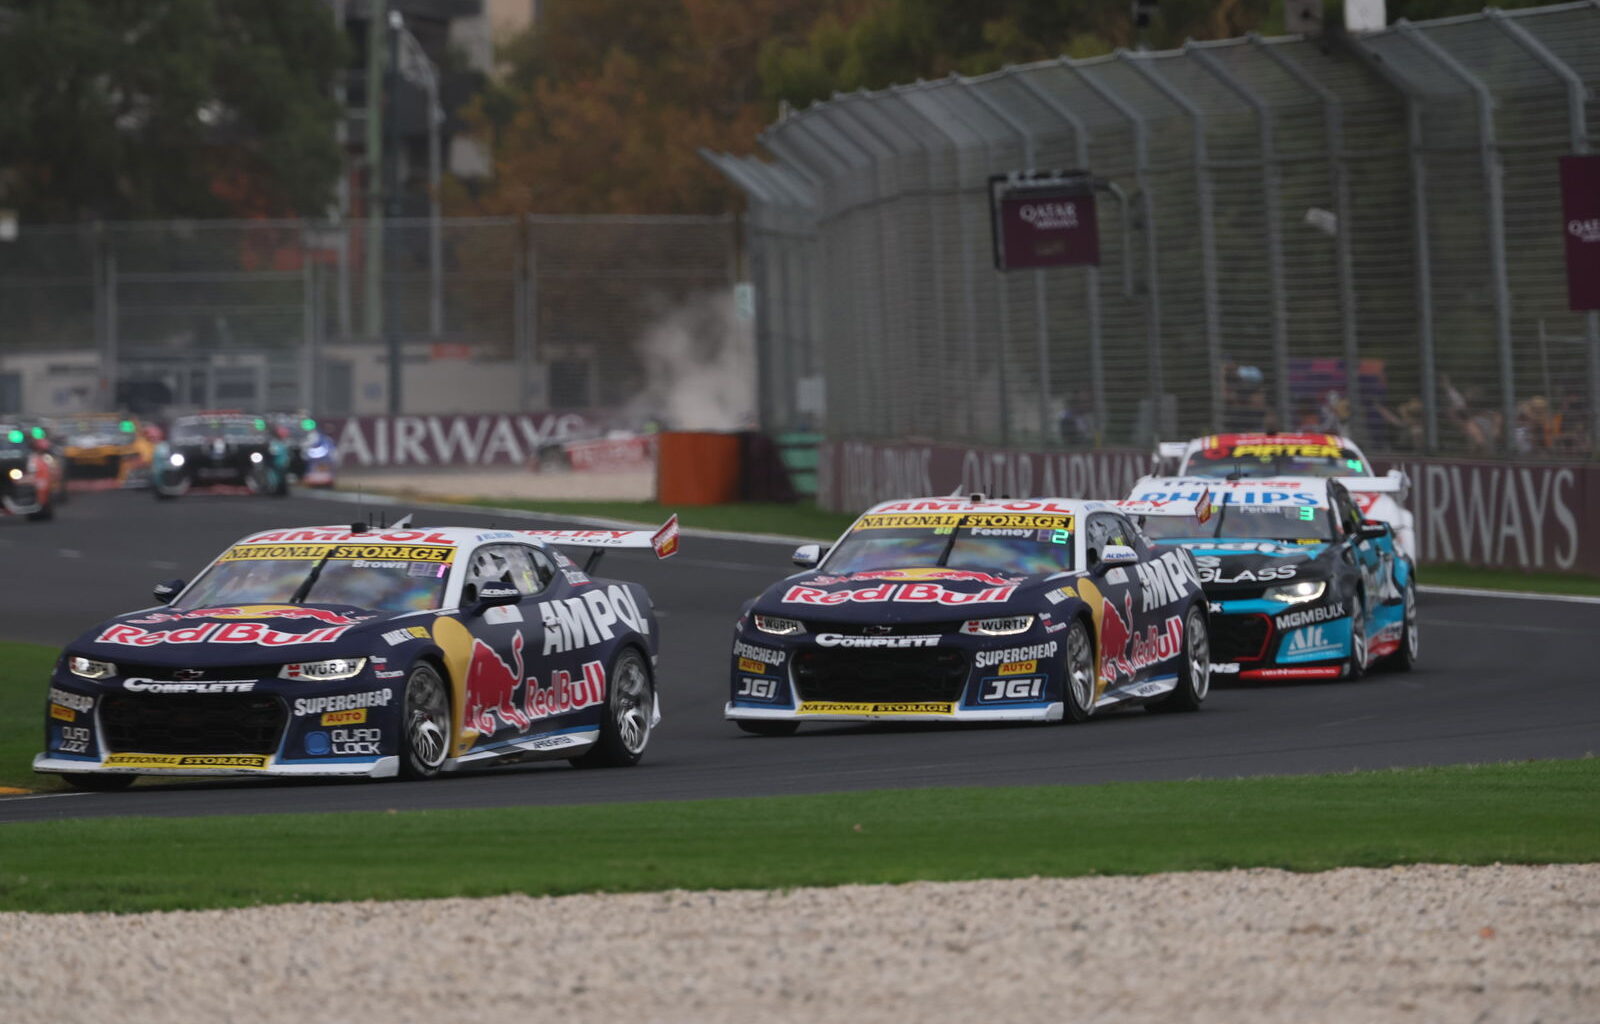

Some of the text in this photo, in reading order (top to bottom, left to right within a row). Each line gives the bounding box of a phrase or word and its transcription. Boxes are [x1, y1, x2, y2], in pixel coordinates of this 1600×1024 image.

[1139, 492, 1318, 504] PHILIPS
[1299, 507, 1314, 521] 3
[1412, 464, 1579, 569] IRWAYS
[861, 515, 1070, 528] NATIONAL STORAGE
[971, 528, 1034, 537] Feeney
[1051, 529, 1069, 544] 2
[226, 547, 446, 560] NATIONAL STORAGE
[352, 560, 407, 569] Brown
[782, 584, 1019, 605] Red Bull
[538, 584, 650, 655] AMPOL
[95, 623, 216, 645] Red
[212, 623, 355, 646] Bull
[815, 633, 941, 648] COMPLETE
[975, 641, 1058, 668] SUPERCHEAP
[1003, 663, 1033, 672] AUTO
[123, 677, 257, 693] COMPLETE
[738, 678, 777, 698] JGI
[984, 679, 1042, 700] JGI
[294, 688, 392, 716] SUPERCHEAP
[801, 703, 949, 712] NATIONAL STORAGE
[326, 713, 362, 723] AUTO
[331, 728, 381, 742] QUAD
[331, 742, 381, 754] LOCK
[106, 756, 263, 766] NATIONAL STORAGE
